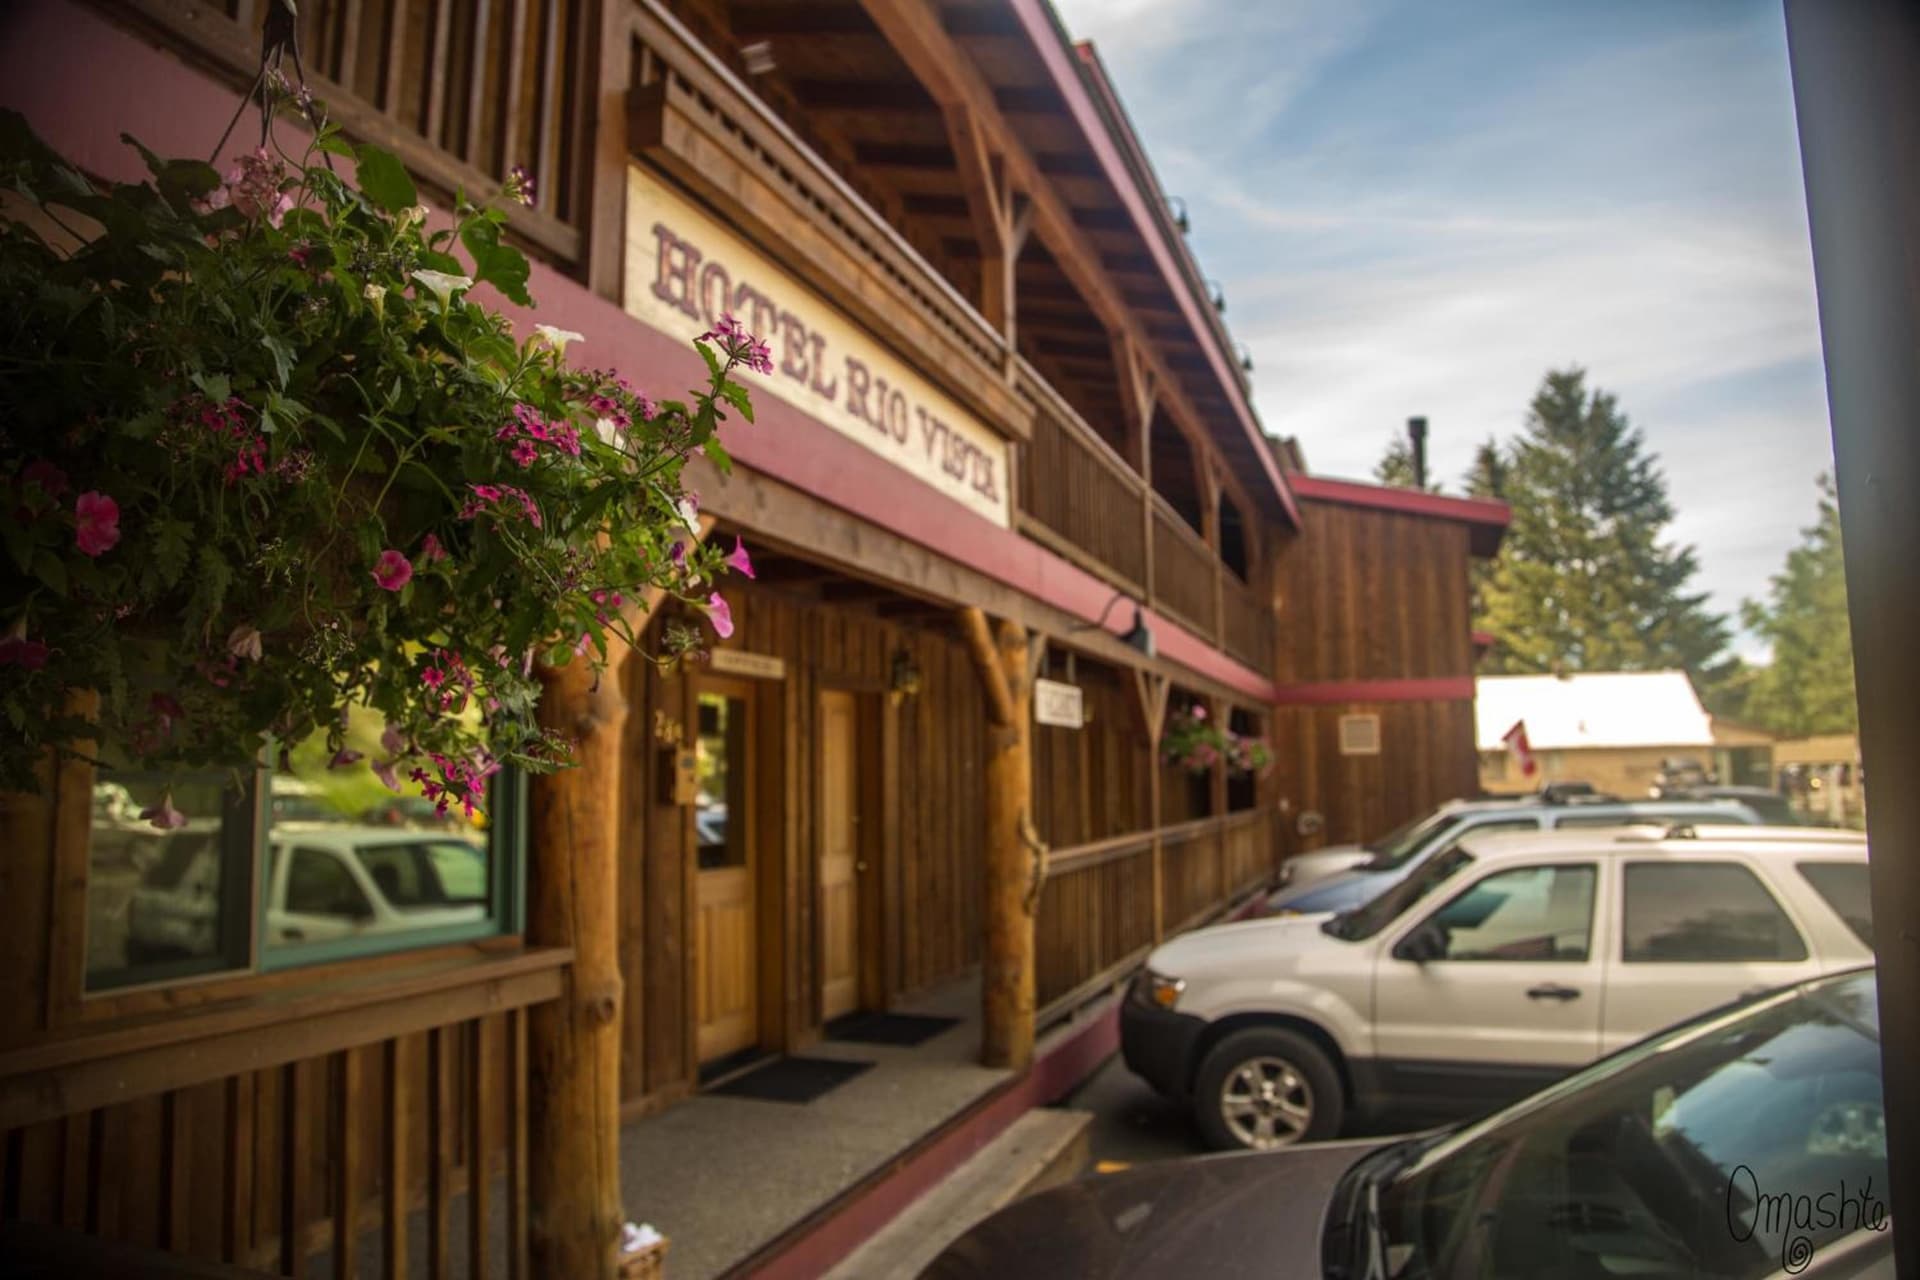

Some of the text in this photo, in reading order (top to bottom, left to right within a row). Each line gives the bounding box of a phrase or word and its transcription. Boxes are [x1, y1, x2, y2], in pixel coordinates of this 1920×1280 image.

[651, 223, 999, 503] HOTEL RIO VISTA
